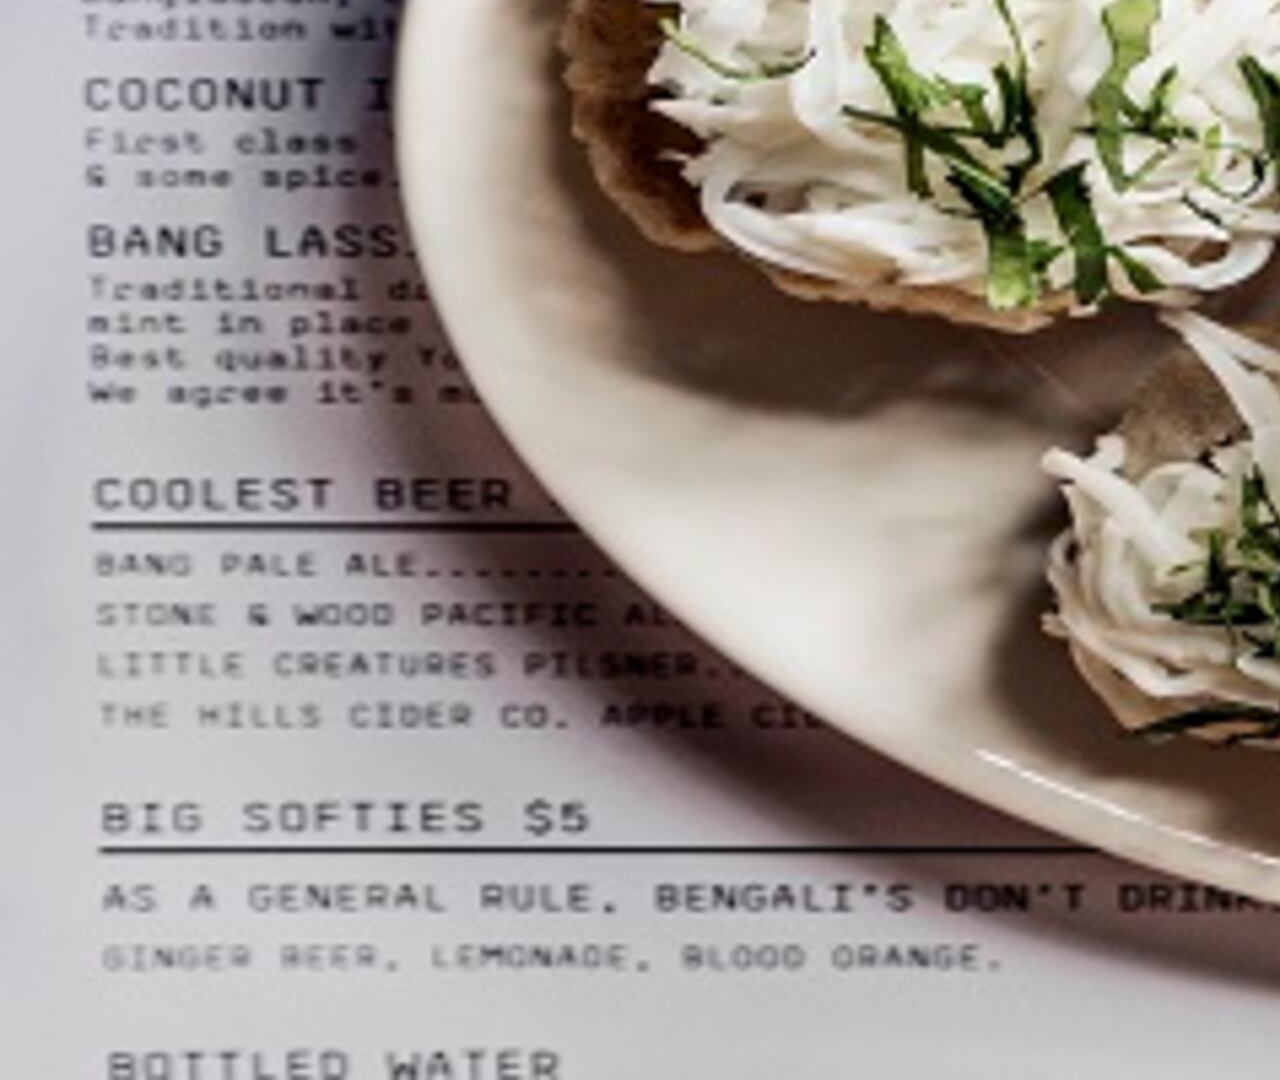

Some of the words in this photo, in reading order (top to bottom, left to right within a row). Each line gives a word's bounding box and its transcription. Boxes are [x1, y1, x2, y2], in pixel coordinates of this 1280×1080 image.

[82, 75, 326, 114] COCONUT
[86, 222, 224, 260] BANG
[86, 312, 186, 336] mint
[217, 310, 264, 336] in
[288, 309, 413, 338] place
[92, 476, 334, 513] COOLEST
[373, 476, 513, 515] BEER
[101, 800, 203, 835] BIG
[241, 800, 484, 834] SOFTIES
[523, 796, 590, 838] $5
[101, 882, 158, 915] AS
[188, 883, 216, 910] A
[247, 882, 446, 914] GENERAL
[100, 942, 253, 974] GINGER
[680, 942, 808, 973] BLOOD
[107, 1047, 350, 1080] BOTTLED
[385, 1047, 560, 1080] WATER
